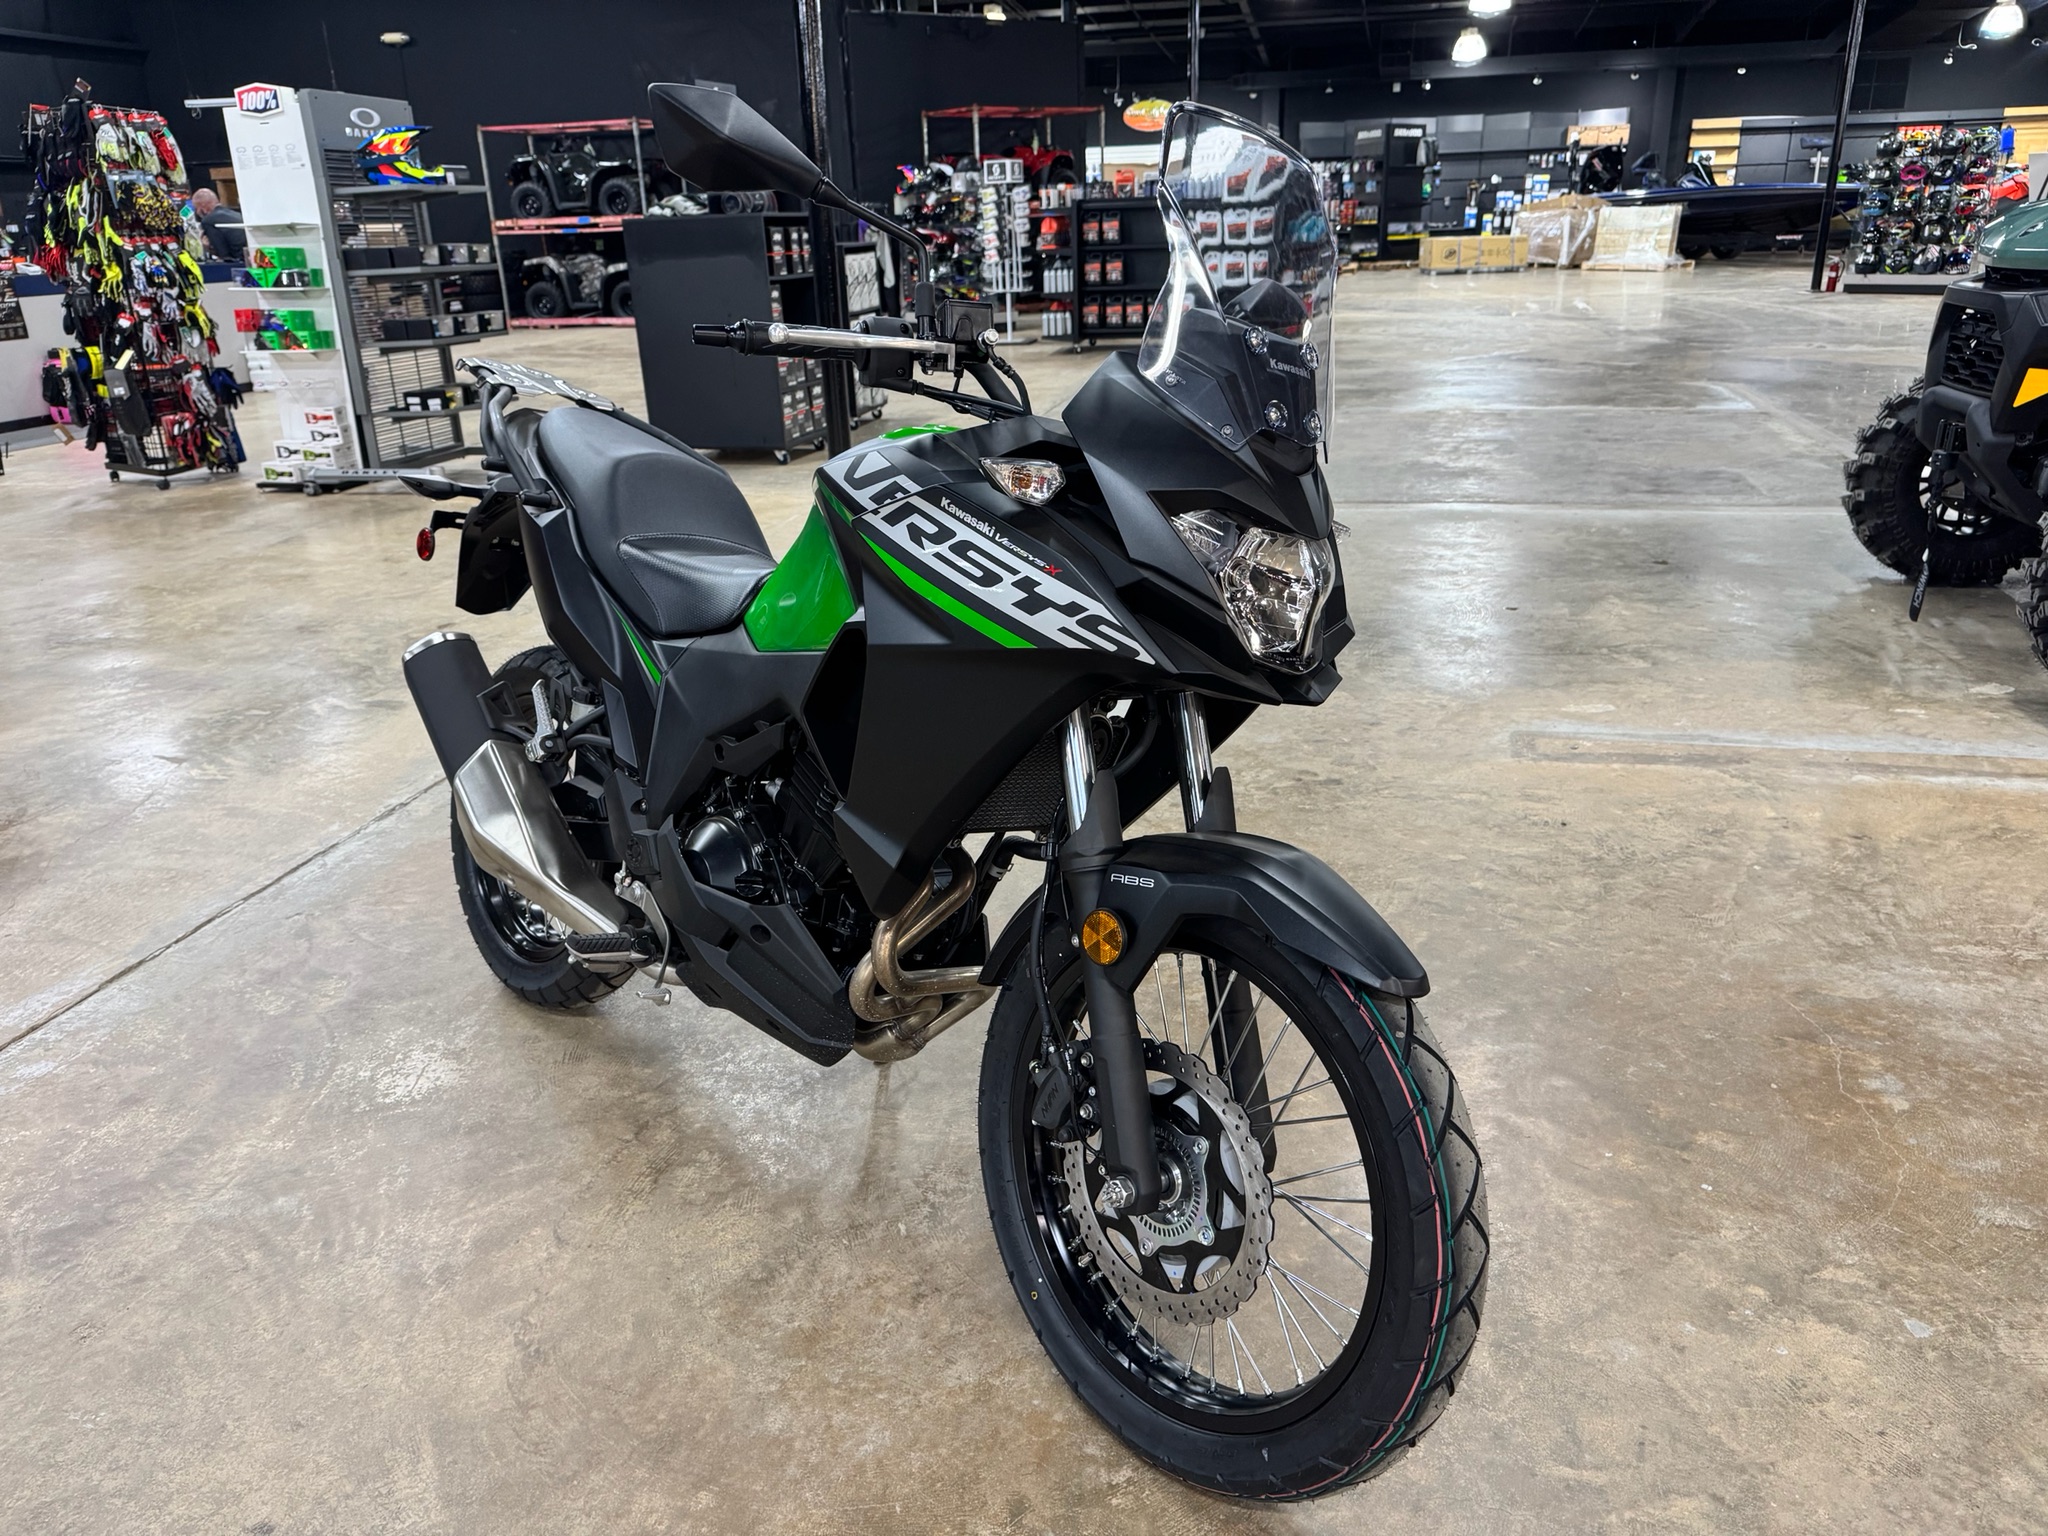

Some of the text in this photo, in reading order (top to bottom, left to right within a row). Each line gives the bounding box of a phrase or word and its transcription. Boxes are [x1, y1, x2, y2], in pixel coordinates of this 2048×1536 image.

[240, 90, 277, 110] 100%
[1269, 357, 1311, 380] Kawasaki
[940, 496, 996, 538] Kawasaki
[843, 450, 1141, 660] VERSYS
[1110, 873, 1155, 888] ABS
